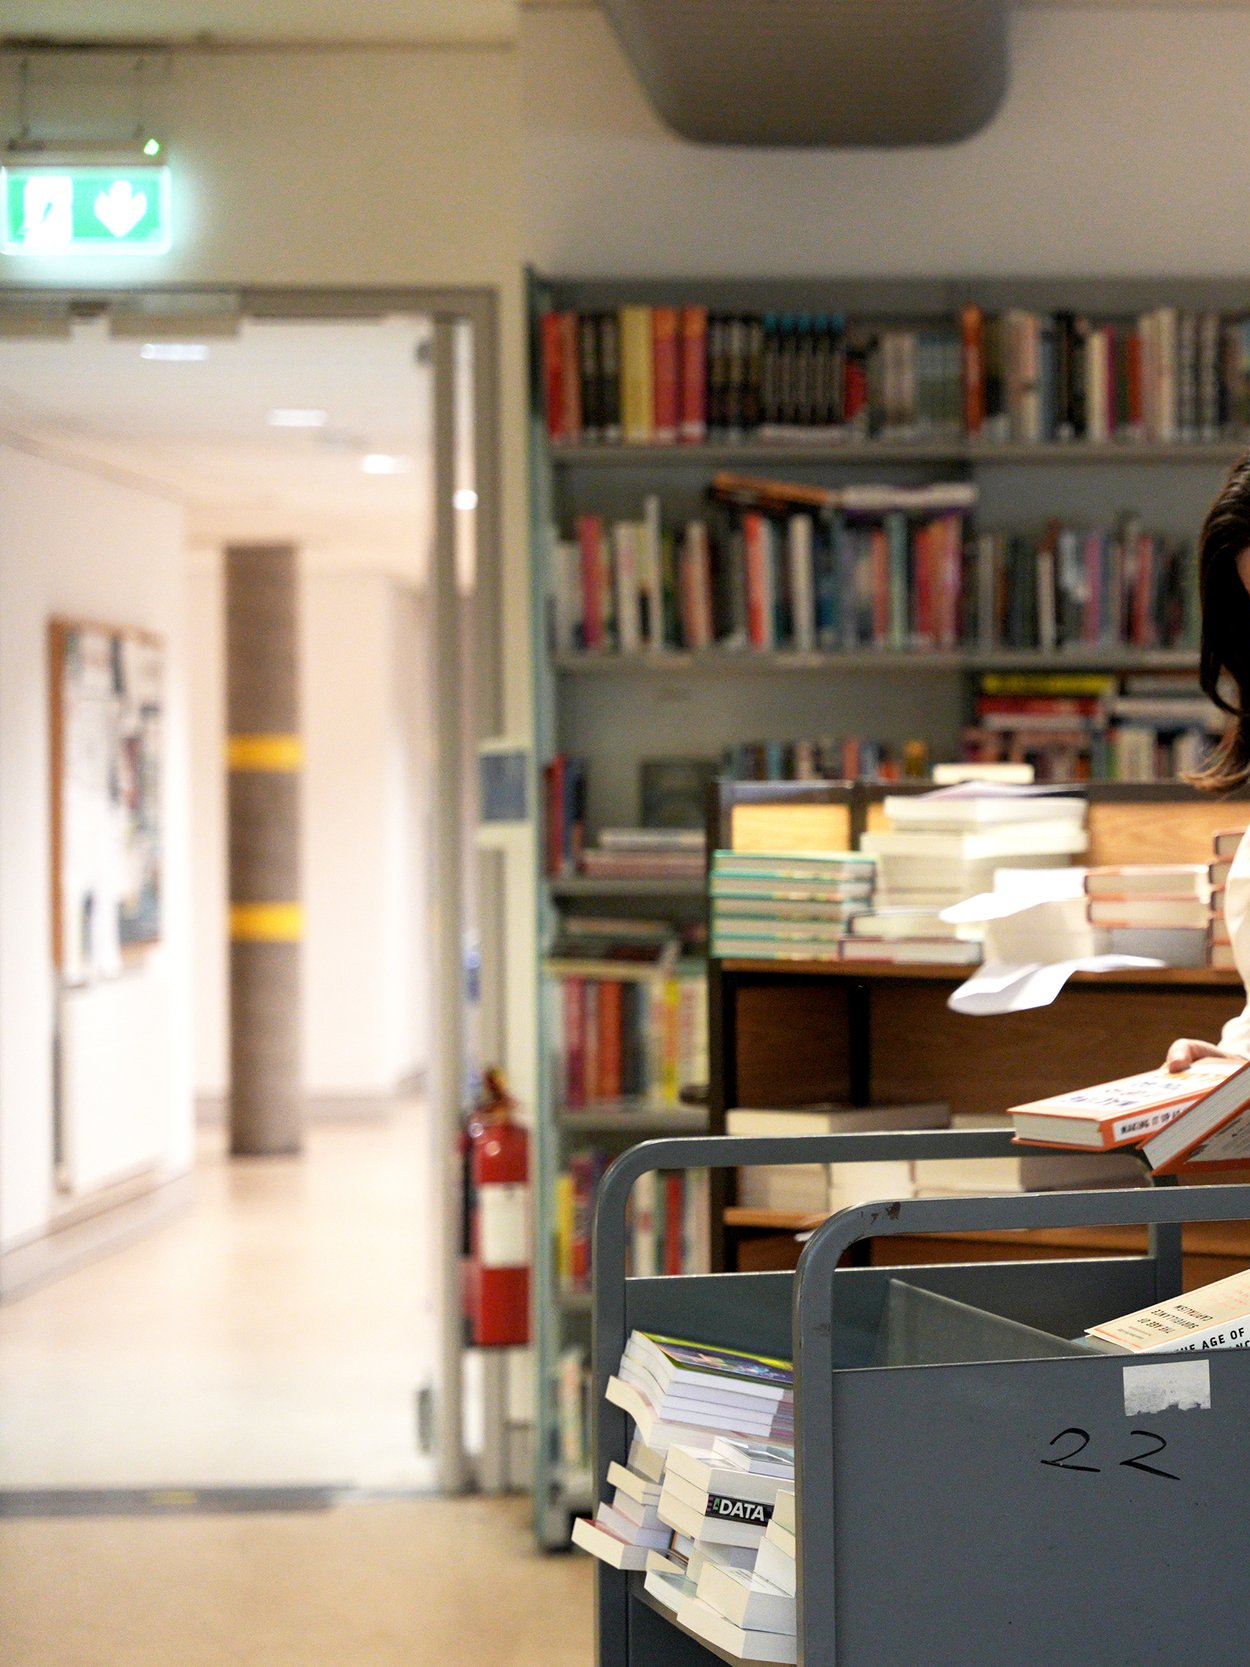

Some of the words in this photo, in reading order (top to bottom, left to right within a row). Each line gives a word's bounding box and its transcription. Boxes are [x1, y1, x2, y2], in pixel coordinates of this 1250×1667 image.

[1121, 1118, 1150, 1134] MAKING
[1151, 1309, 1200, 1330] SURVEILLANCE
[1174, 1304, 1214, 1322] CAPITALISM
[1146, 1321, 1162, 1331] AGE
[1202, 1334, 1226, 1350] AGE
[1230, 1327, 1245, 1340] OF
[718, 1498, 765, 1522] DATA
